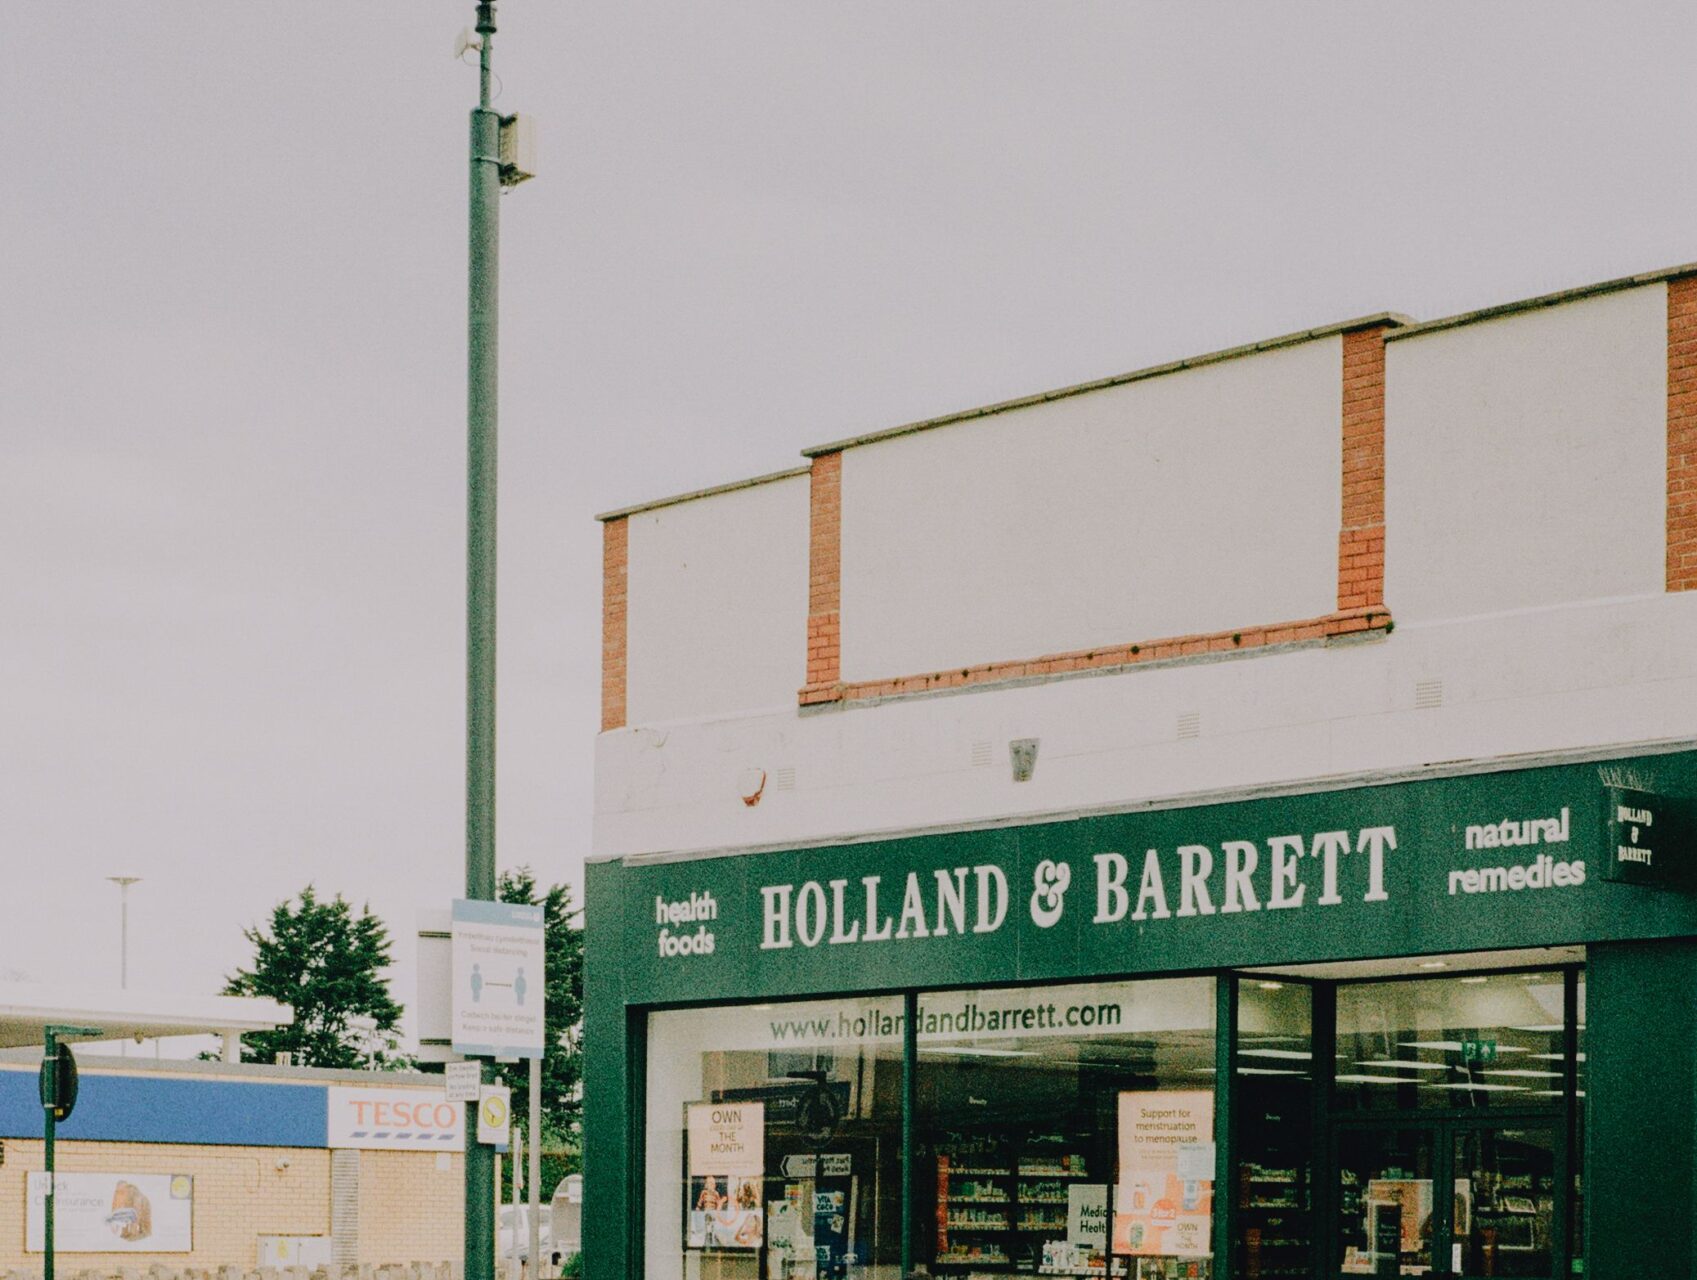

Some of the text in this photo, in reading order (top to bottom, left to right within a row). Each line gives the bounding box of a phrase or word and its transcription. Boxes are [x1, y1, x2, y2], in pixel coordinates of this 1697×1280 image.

[1465, 807, 1570, 850] natural
[1618, 845, 1652, 866] BARRETT
[1449, 854, 1586, 896] remedies
[760, 826, 1397, 950] HOLLAND & BARRETT
[656, 891, 717, 924] health
[658, 925, 715, 957] foods
[350, 1101, 456, 1128] TESCO
[712, 1110, 742, 1124] OWN
[1140, 1108, 1191, 1120] Support for
[1136, 1122, 1196, 1131] menstruation
[719, 1132, 736, 1141] THE
[1134, 1134, 1198, 1146] to menopause
[711, 1144, 744, 1153] MONTH
[1080, 1220, 1106, 1233] Healt
